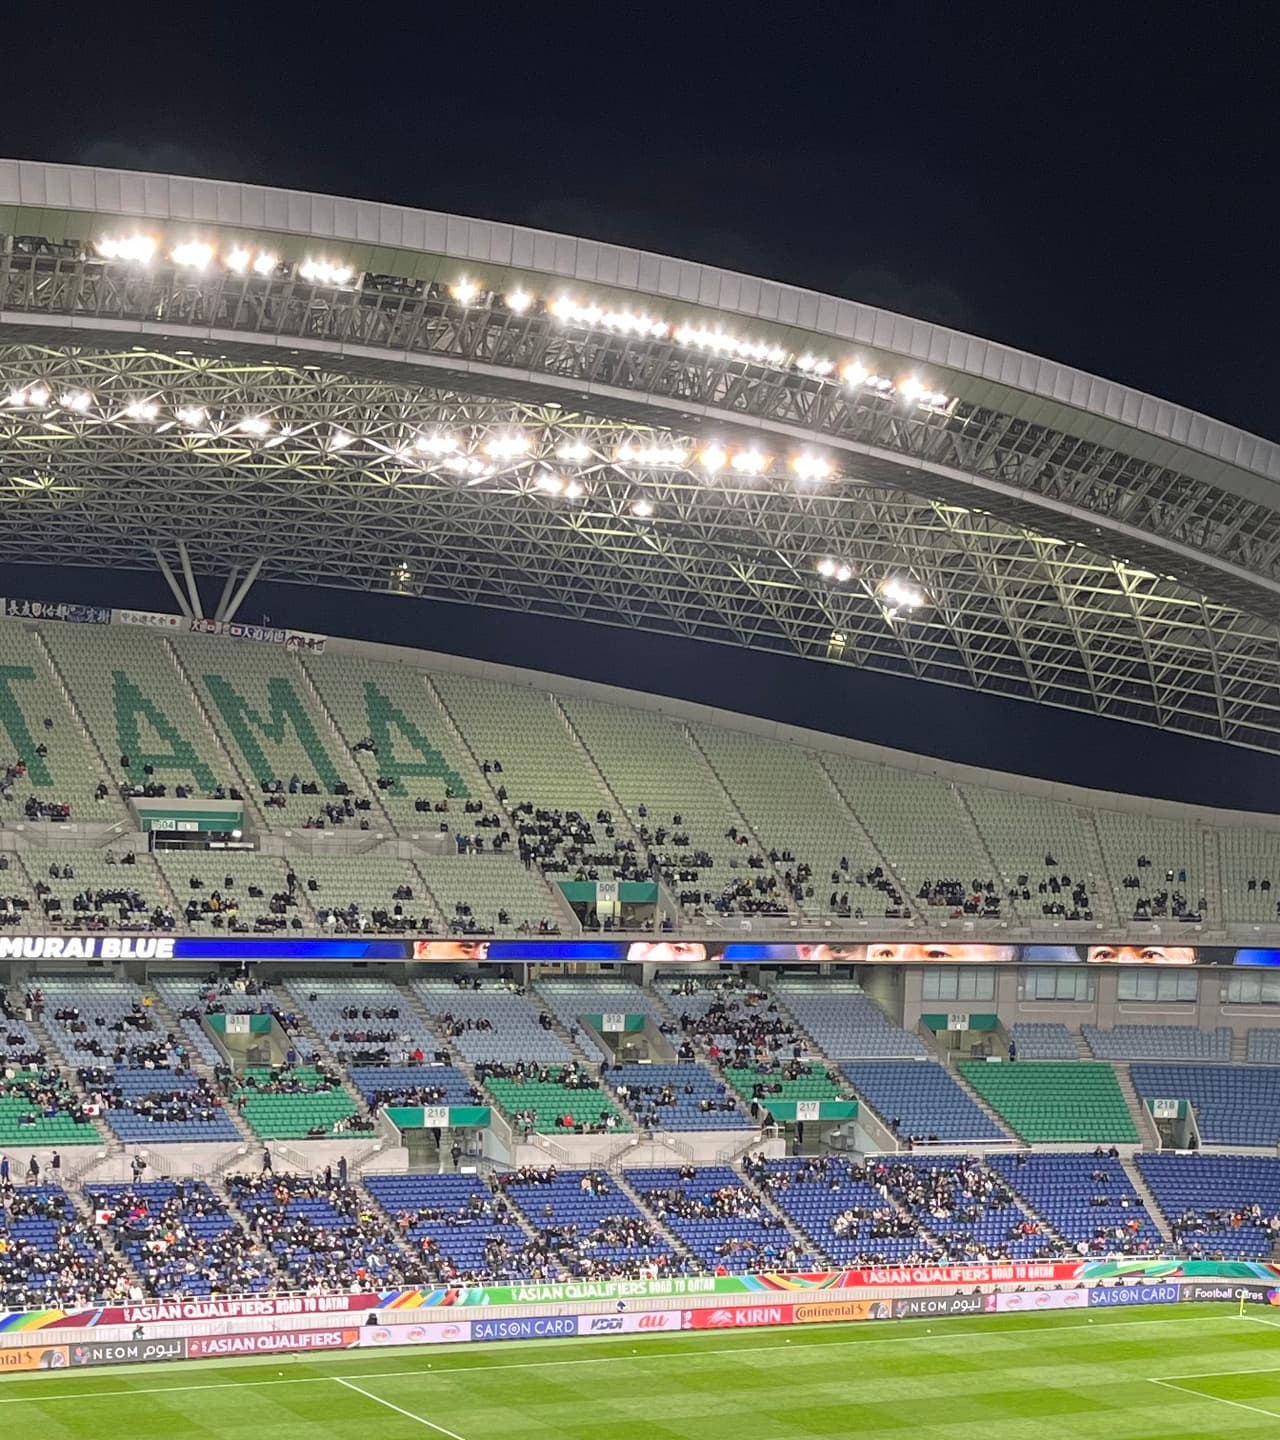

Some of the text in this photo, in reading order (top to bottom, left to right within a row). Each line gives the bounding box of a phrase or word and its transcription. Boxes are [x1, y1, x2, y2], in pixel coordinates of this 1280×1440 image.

[102, 937, 175, 959] BLUE
[428, 1108, 447, 1118] 216
[799, 1103, 817, 1112] 217
[869, 1270, 911, 1286] ASIAN
[914, 1267, 989, 1283] QUALIFIERS
[519, 1285, 563, 1301] ASIAN
[566, 1281, 646, 1298] QUALIFIERS
[1092, 1289, 1138, 1305] SAISON
[1142, 1287, 1176, 1301] CARD
[1195, 1287, 1232, 1300] Football
[131, 1304, 181, 1321] ASIAN
[184, 1300, 273, 1318] QUALIFIERS
[276, 1298, 302, 1314] ROAD
[304, 1298, 316, 1313] TO
[318, 1296, 349, 1312] QATAR
[736, 1307, 782, 1325] KIRIN
[795, 1305, 855, 1322] Continental
[911, 1302, 947, 1314] NEOM
[475, 1322, 531, 1338] SAISON
[535, 1319, 575, 1335] CARD
[590, 1317, 624, 1331] KDDI
[638, 1315, 668, 1328] au
[210, 1336, 256, 1353] ASIAN
[258, 1332, 341, 1351] QUALIFIERS
[93, 1346, 138, 1360] NEOM
